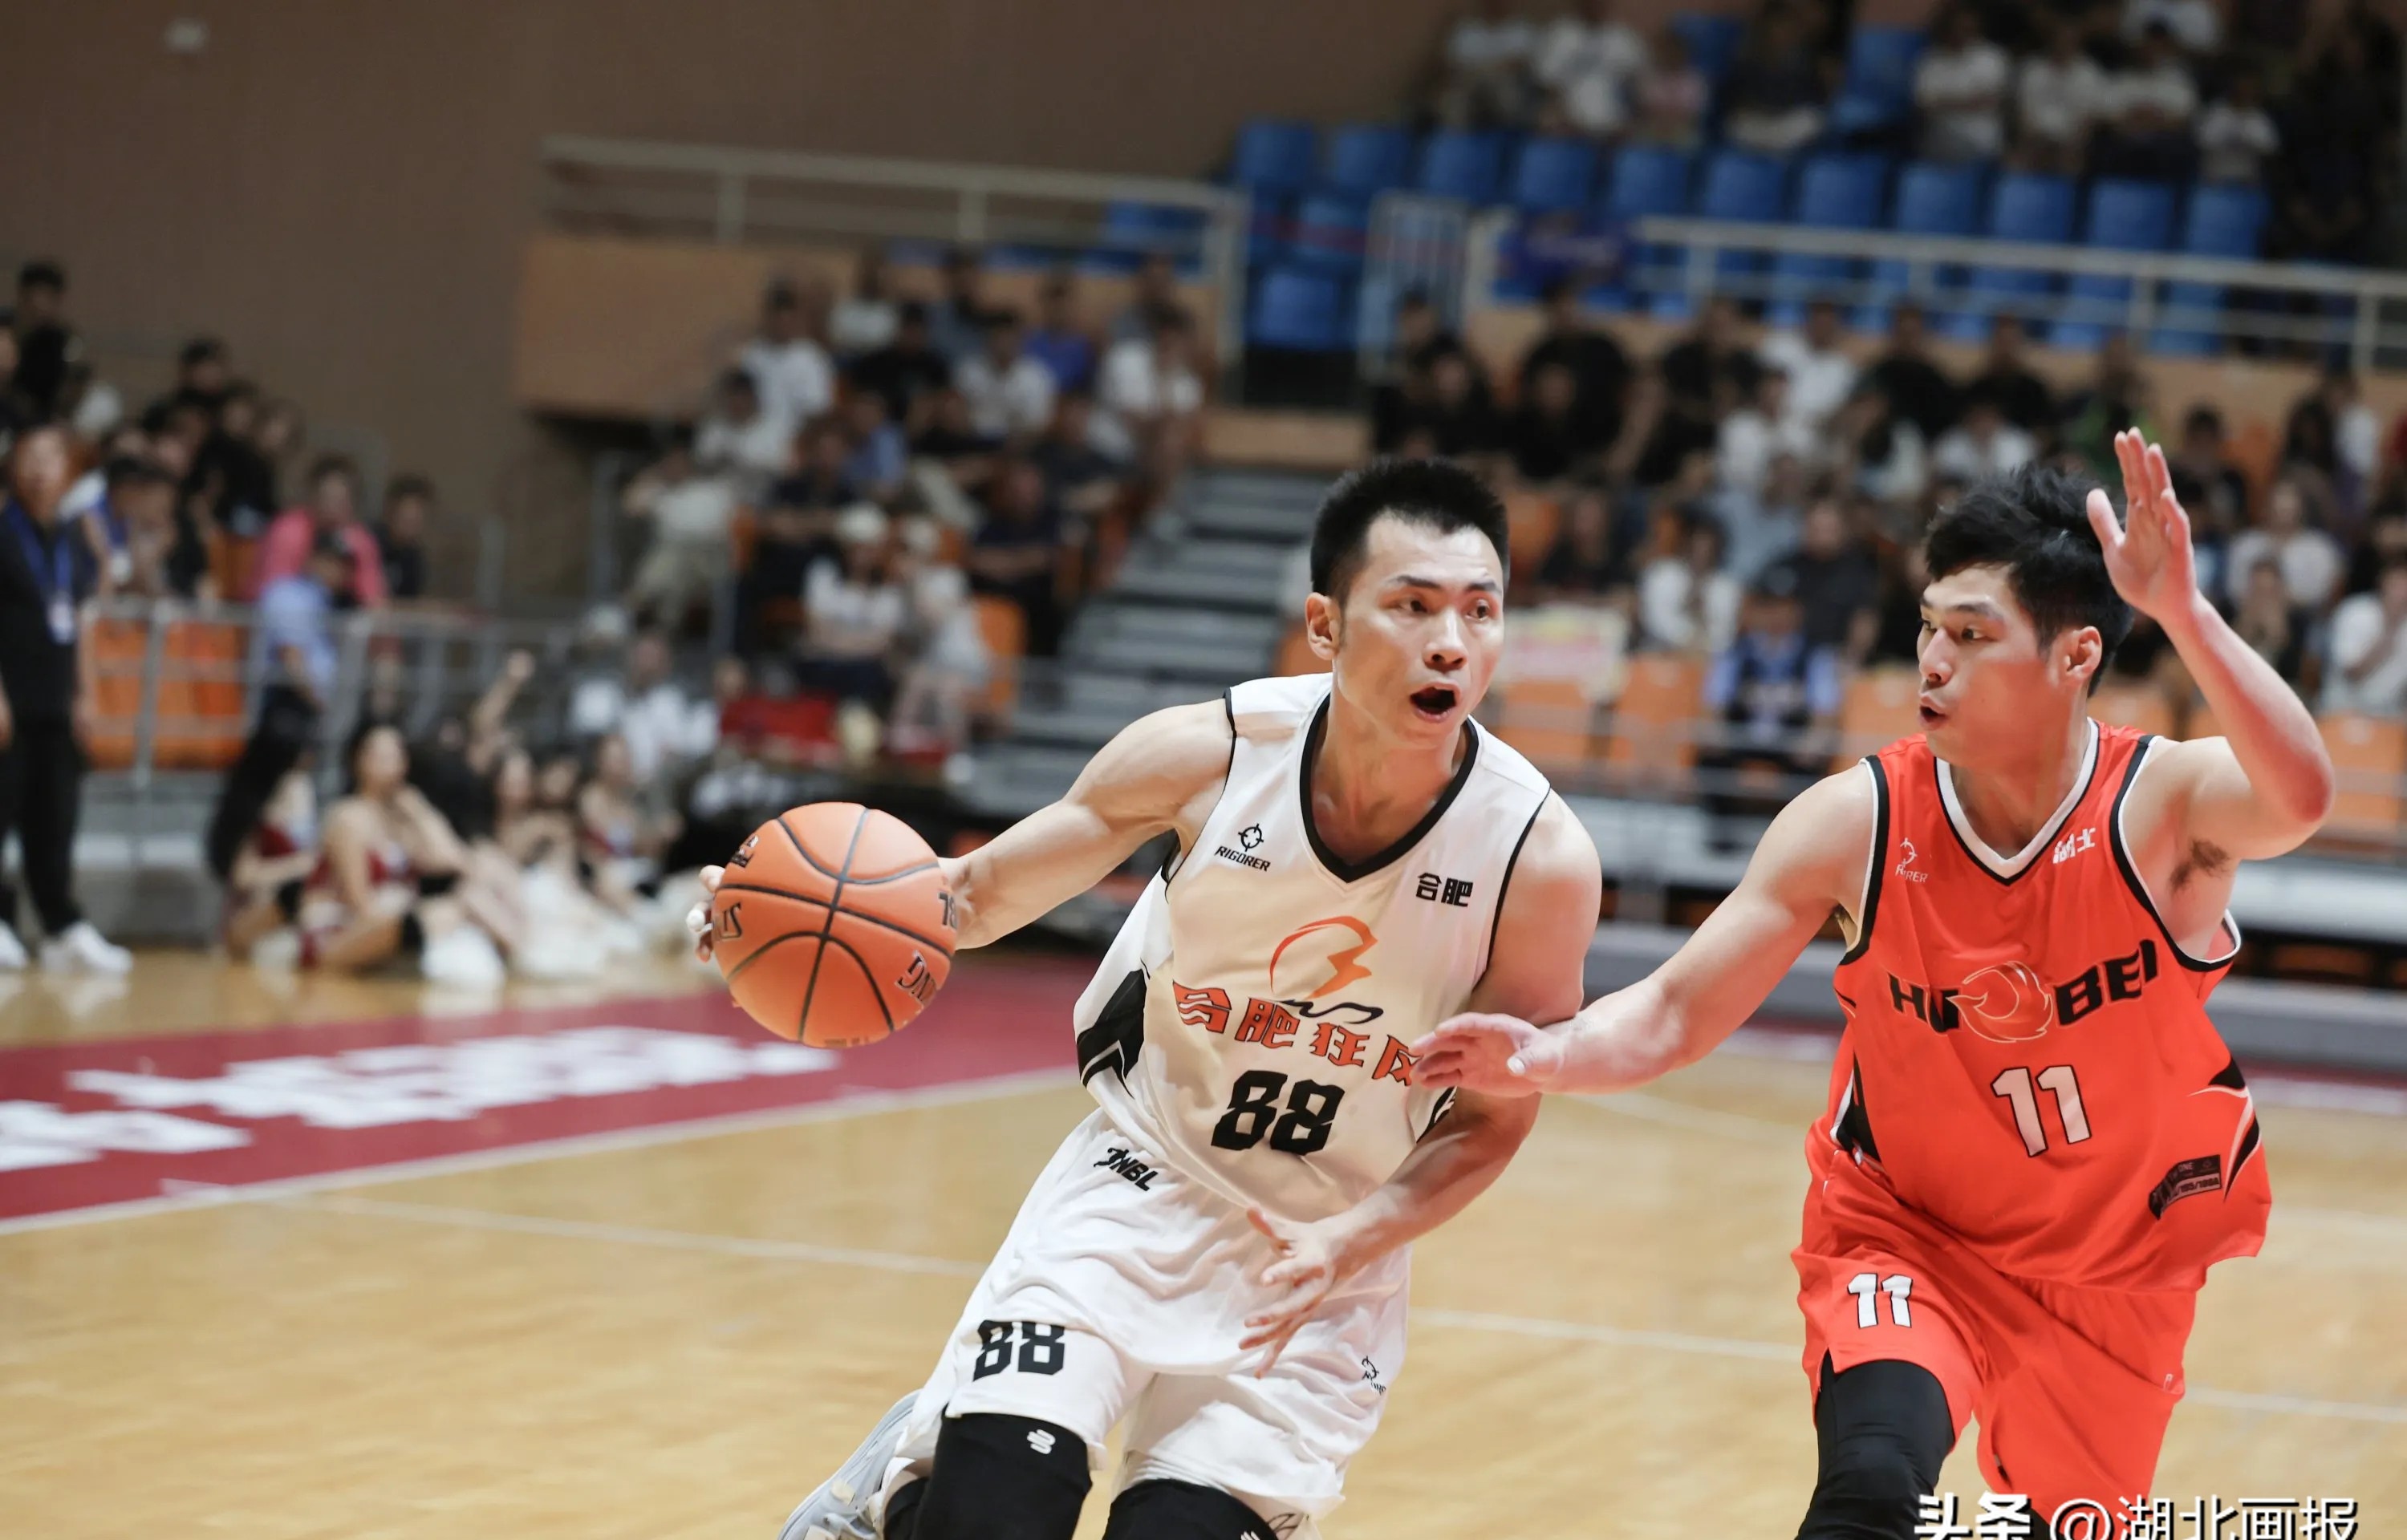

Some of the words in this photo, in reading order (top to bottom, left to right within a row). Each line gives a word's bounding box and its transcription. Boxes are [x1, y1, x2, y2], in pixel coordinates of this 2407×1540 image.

[1214, 845, 1271, 872] RIGORER
[1415, 872, 1474, 907] 合肥
[1211, 1070, 1346, 1156] 88
[1990, 1064, 2092, 1158] 11
[1109, 1156, 1159, 1192] NBL
[1847, 1273, 1914, 1329] 11
[972, 1319, 1065, 1382] 88
